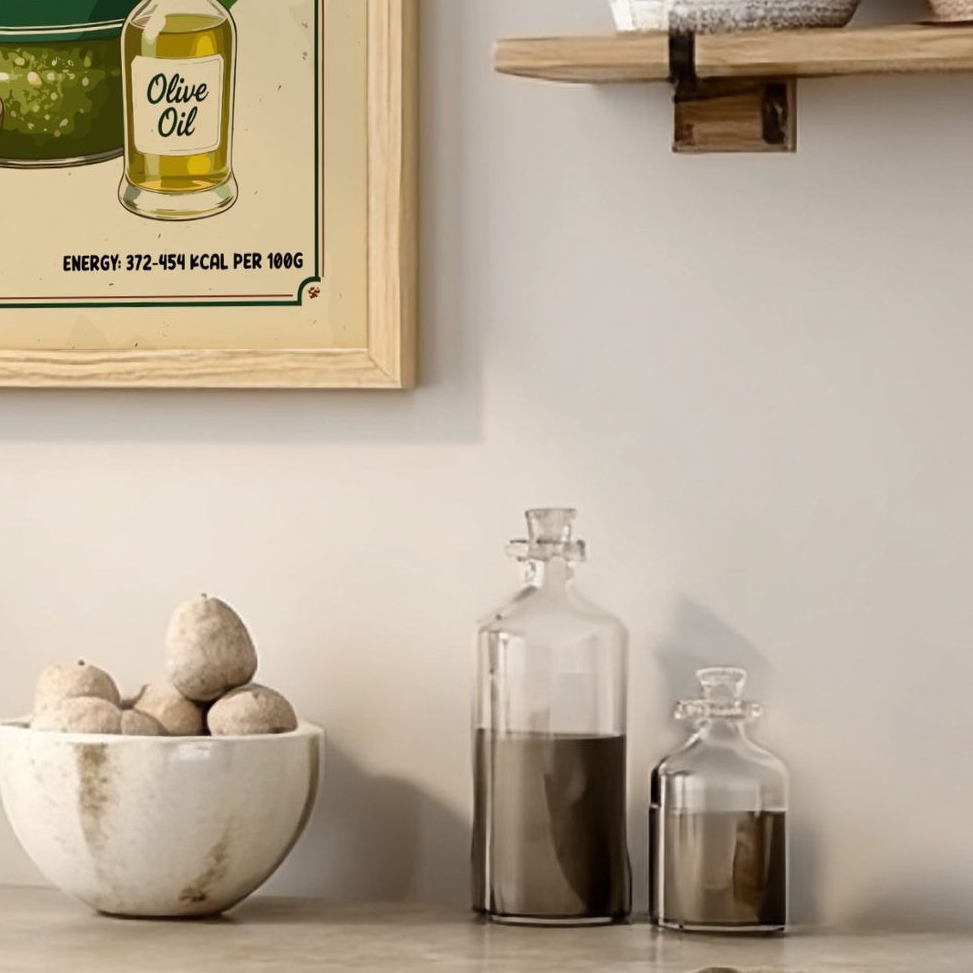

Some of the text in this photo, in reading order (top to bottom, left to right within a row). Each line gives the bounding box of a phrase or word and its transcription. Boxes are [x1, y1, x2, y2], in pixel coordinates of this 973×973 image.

[147, 73, 209, 104] Olive
[158, 106, 198, 137] Oil
[63, 252, 304, 271] ENERGY: 372-454 KCAL PER 100G
